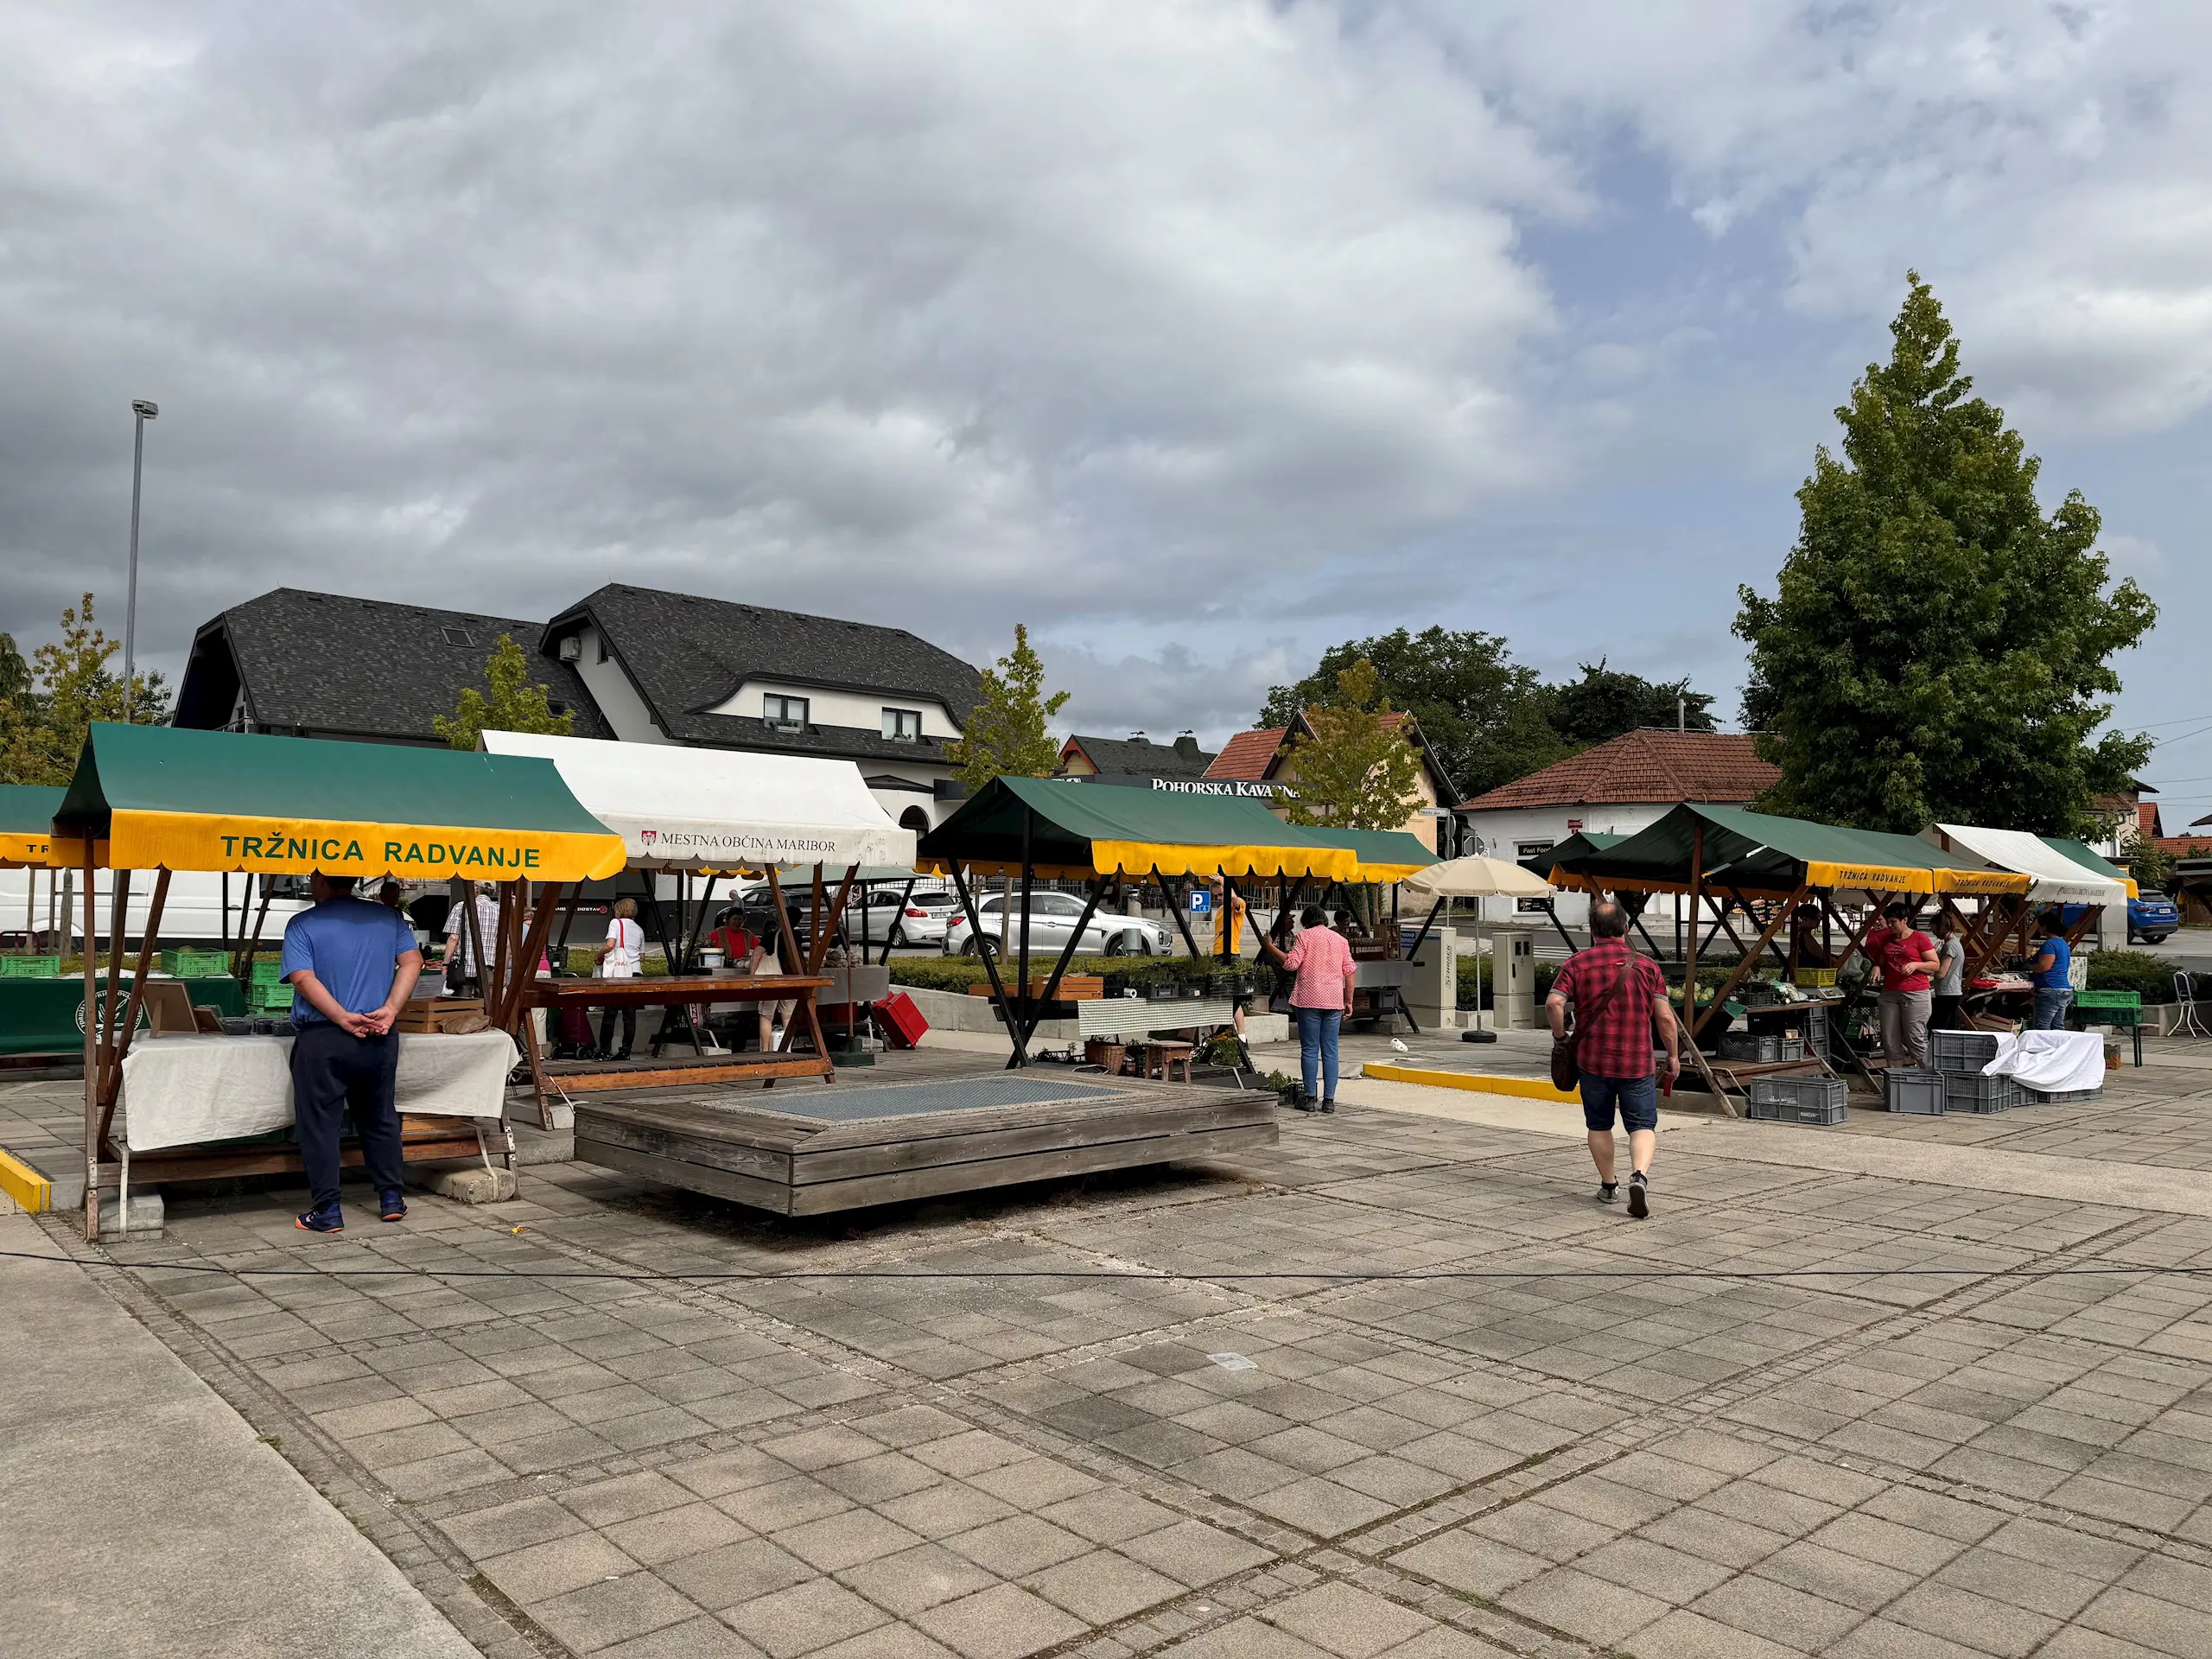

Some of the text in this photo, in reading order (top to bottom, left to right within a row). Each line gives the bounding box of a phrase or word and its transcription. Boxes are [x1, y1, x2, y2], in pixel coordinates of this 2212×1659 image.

[1151, 778, 1234, 795] POHORSKA
[220, 831, 540, 868] TRŽNICA RADVANJE
[660, 832, 836, 852] MESTNA OBČINA MARIBOR
[1839, 869, 1906, 884] TRŽNICA RADVANJE
[1192, 893, 1204, 909] P
